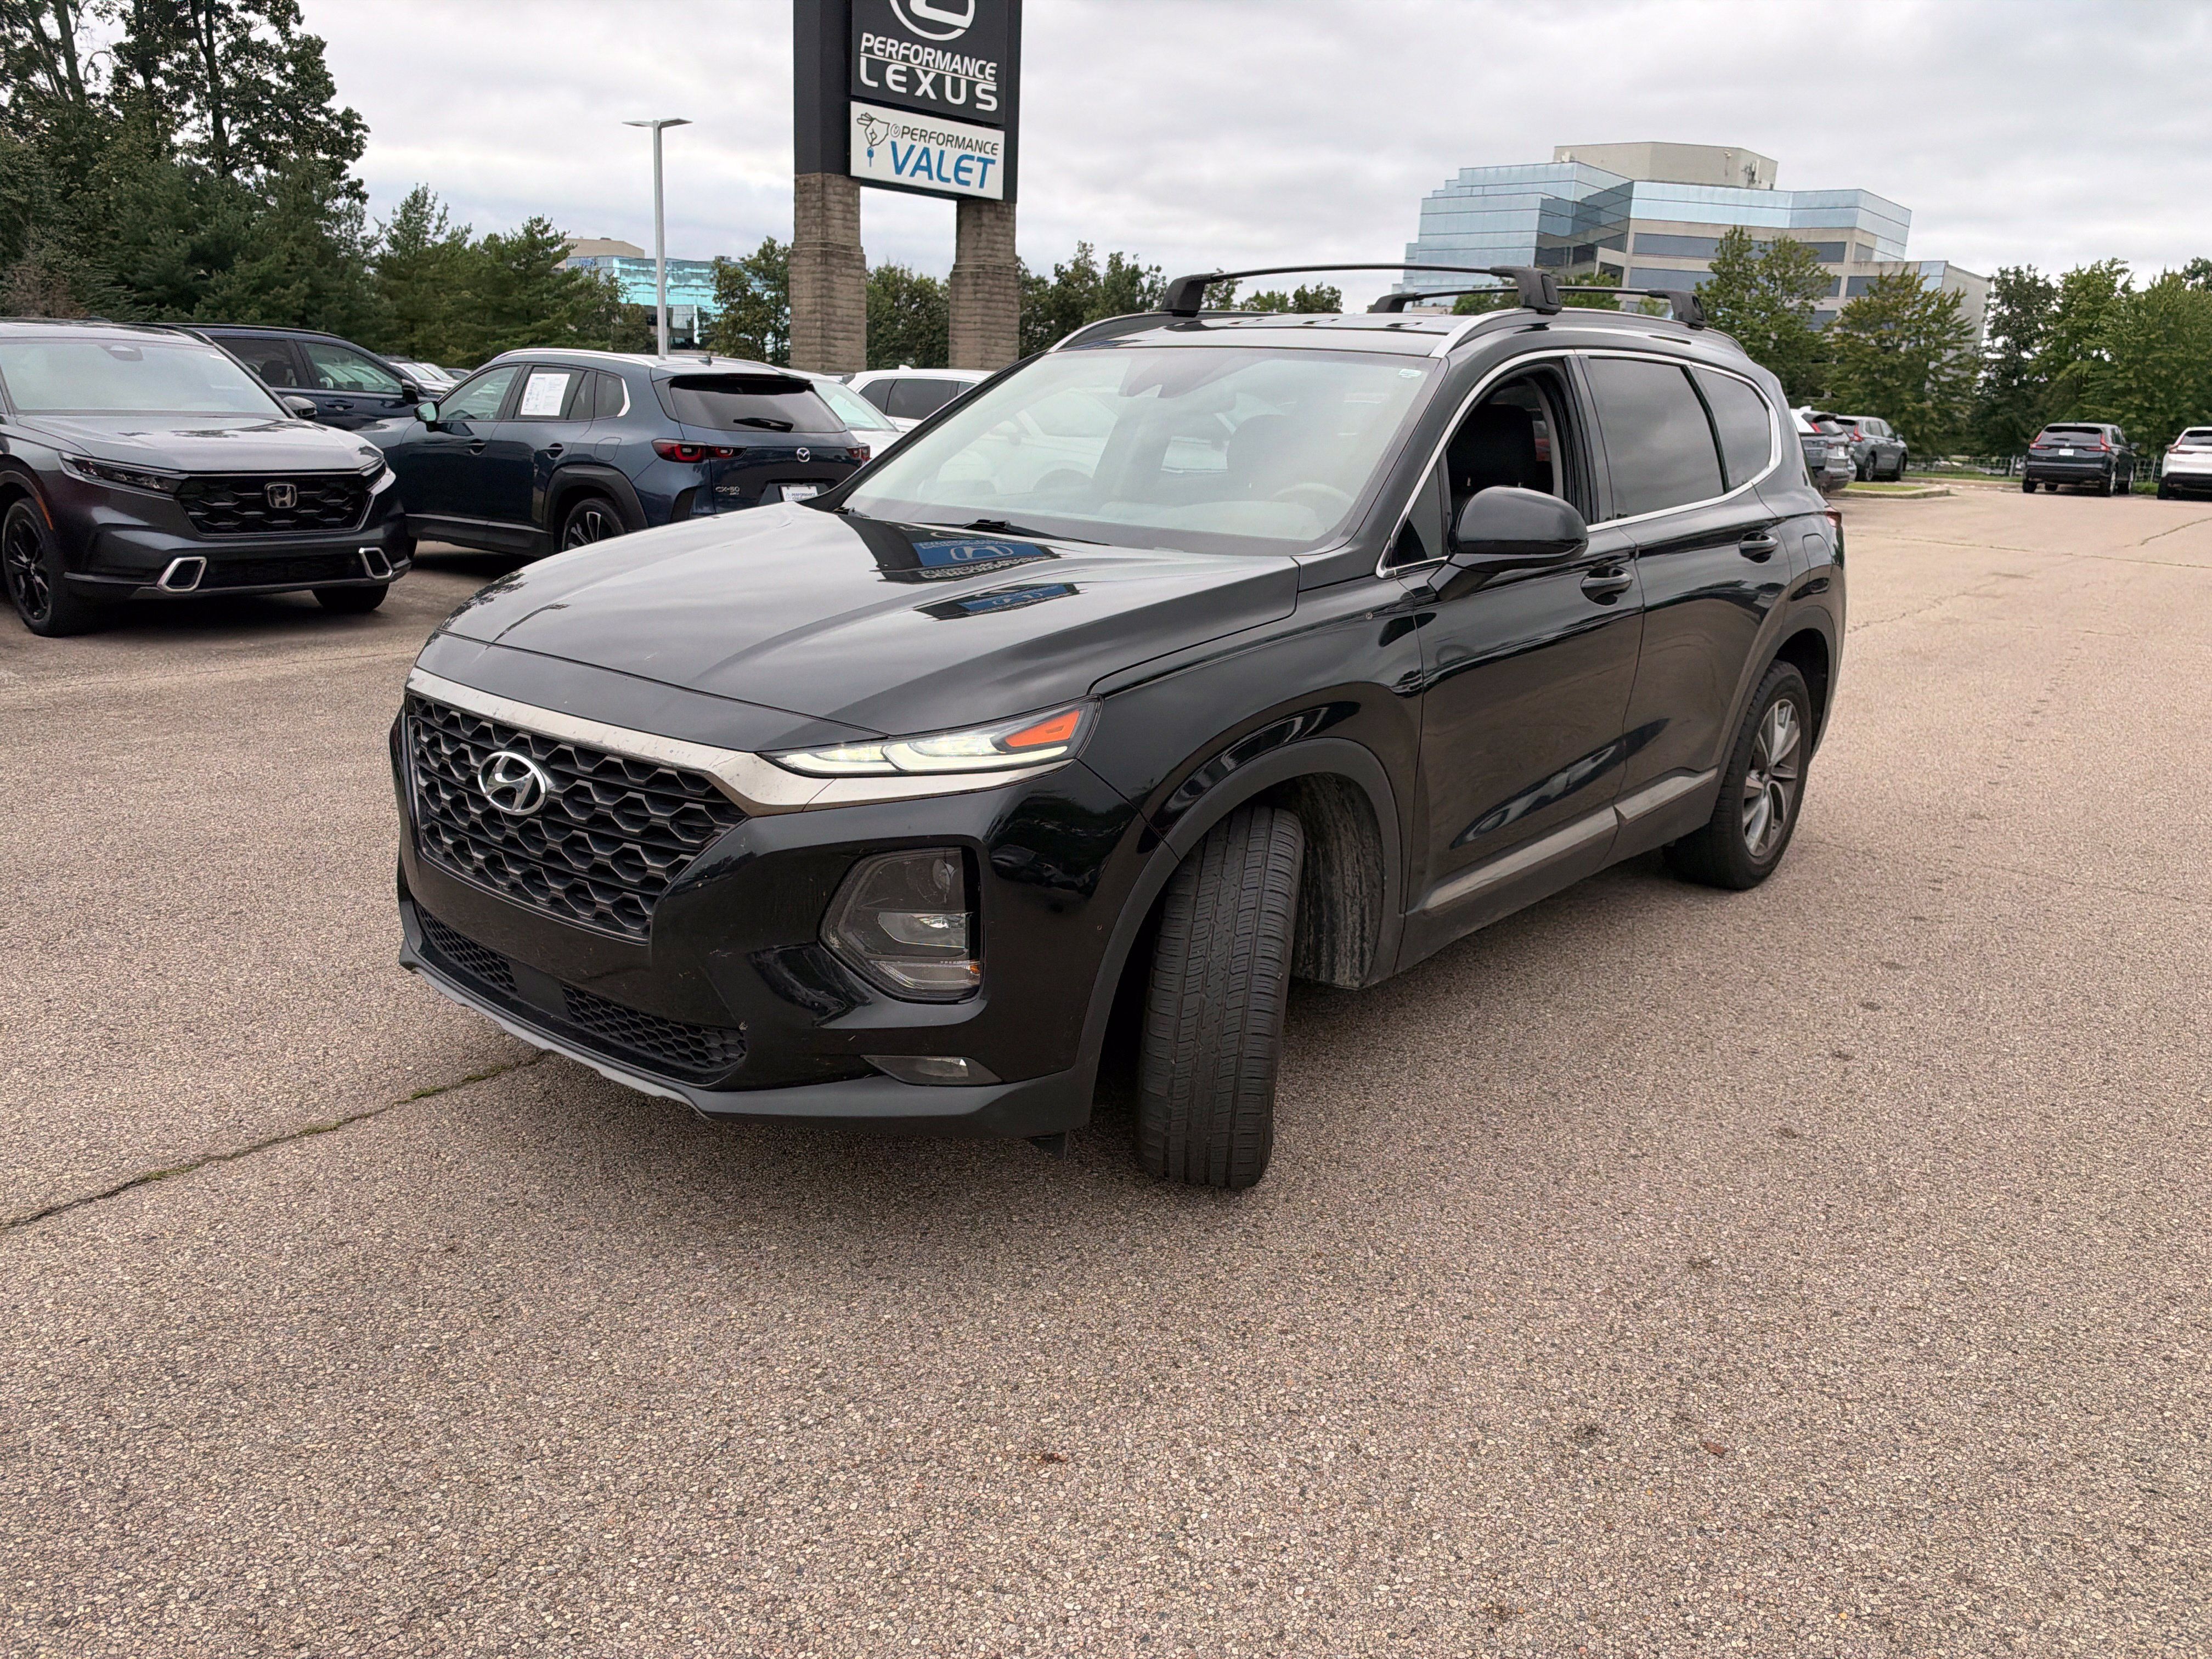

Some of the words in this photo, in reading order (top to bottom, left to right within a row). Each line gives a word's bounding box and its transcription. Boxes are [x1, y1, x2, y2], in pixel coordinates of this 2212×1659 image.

[860, 32, 997, 81] PERFORMANCE
[860, 56, 997, 111] LEXUS
[890, 140, 996, 189] VALET
[901, 126, 1000, 156] PERFORMANCE
